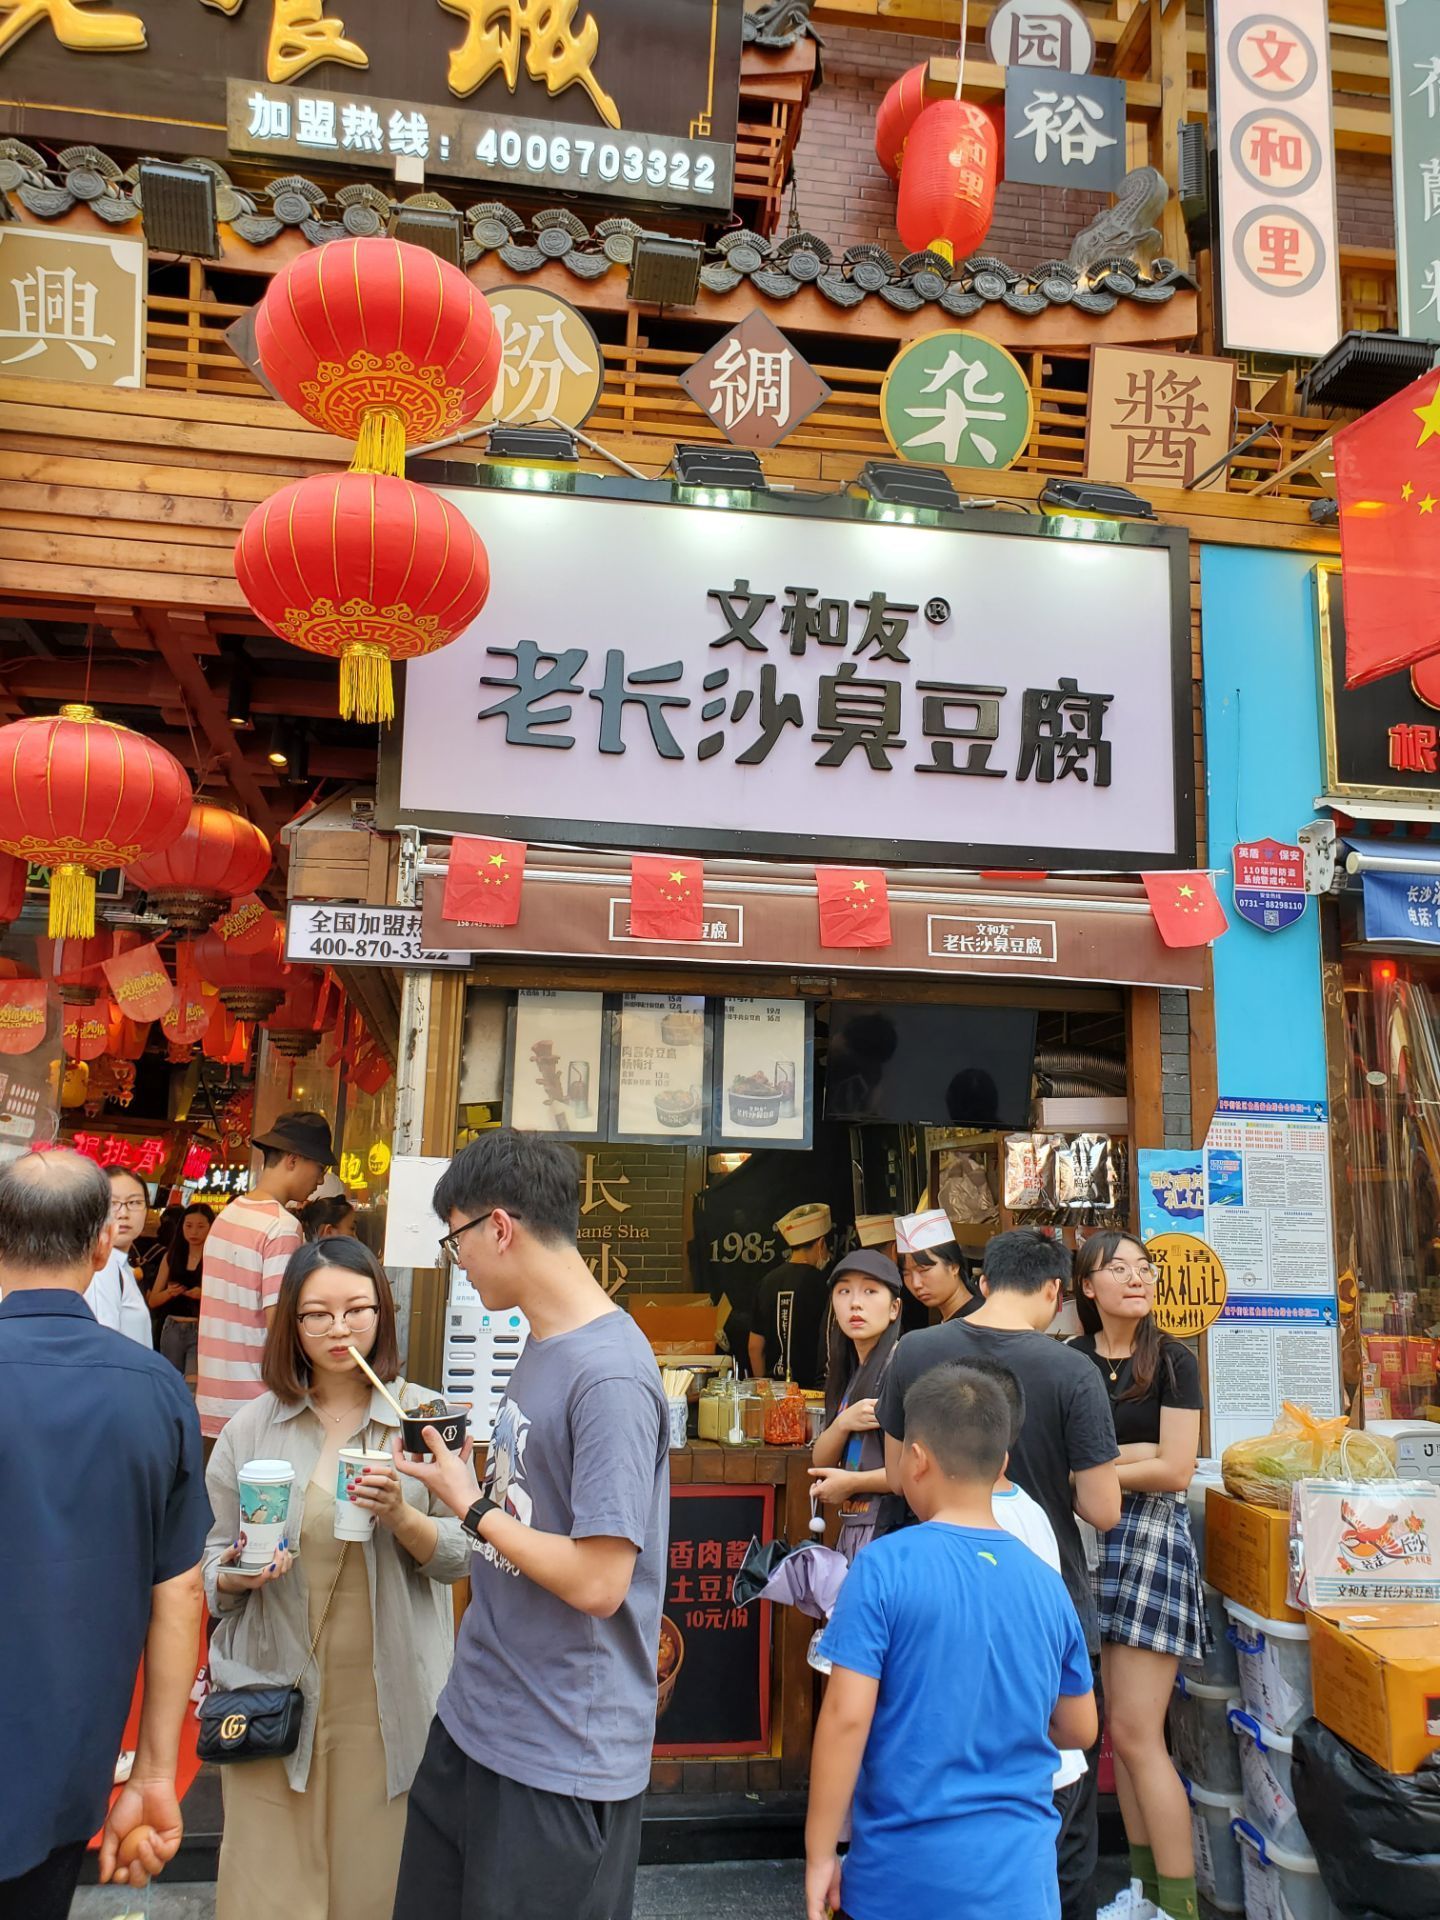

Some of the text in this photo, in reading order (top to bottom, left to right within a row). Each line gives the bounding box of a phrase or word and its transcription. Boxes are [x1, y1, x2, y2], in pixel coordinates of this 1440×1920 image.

[1009, 13, 1072, 66] 园
[475, 127, 718, 193] 4006703322
[1013, 89, 1118, 168] 裕
[1246, 30, 1304, 279] 文和里
[1, 265, 117, 371] 興
[903, 350, 1006, 464] 杂
[706, 578, 921, 664] 文和友
[477, 639, 1116, 788] 老长沙臭豆腐
[1279, 849, 1301, 861] 保安
[943, 934, 1042, 955] 老长沙臭豆腐
[618, 1224, 650, 1239] Sha
[709, 1231, 776, 1264] 1985
[685, 1606, 749, 1631] 10元/份
